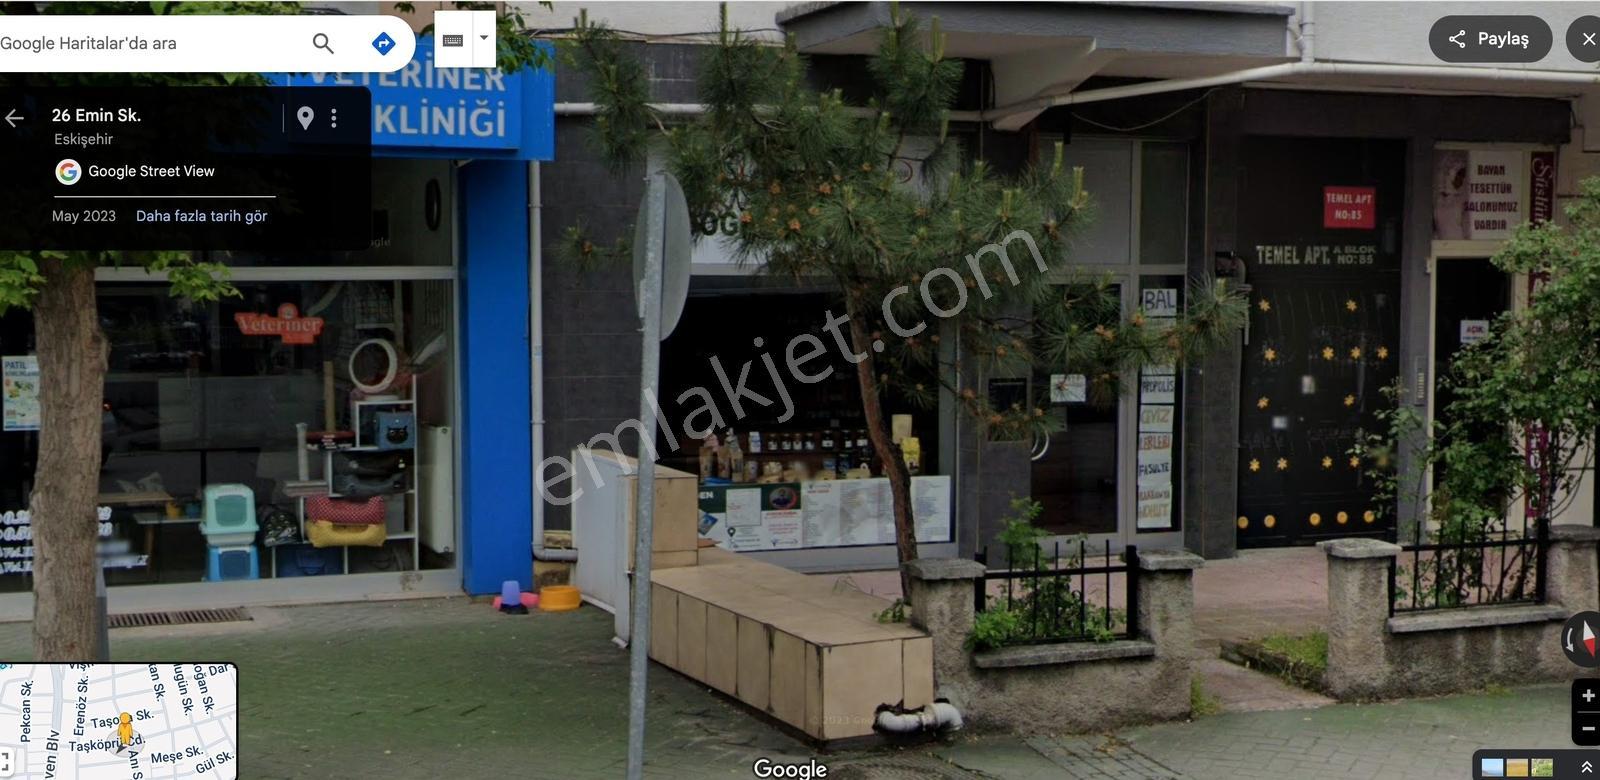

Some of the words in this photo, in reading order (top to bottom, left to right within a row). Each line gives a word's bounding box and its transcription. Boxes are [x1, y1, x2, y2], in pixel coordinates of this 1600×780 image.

[374, 98, 506, 137] KLİNİĞİ
[1478, 164, 1505, 176] BAYAN
[1470, 182, 1512, 194] TESETTÜR
[1326, 192, 1353, 204] TEMEL
[1355, 194, 1372, 204] APT
[1463, 201, 1518, 212] SALONUMUZ
[1474, 219, 1507, 230] VARDIR
[1255, 245, 1300, 265] TEMEL
[1303, 245, 1331, 265] APT.
[1333, 245, 1342, 254] A
[1344, 245, 1376, 254] BLOK
[1144, 290, 1175, 311] BAL
[238, 315, 321, 332] Veteriner
